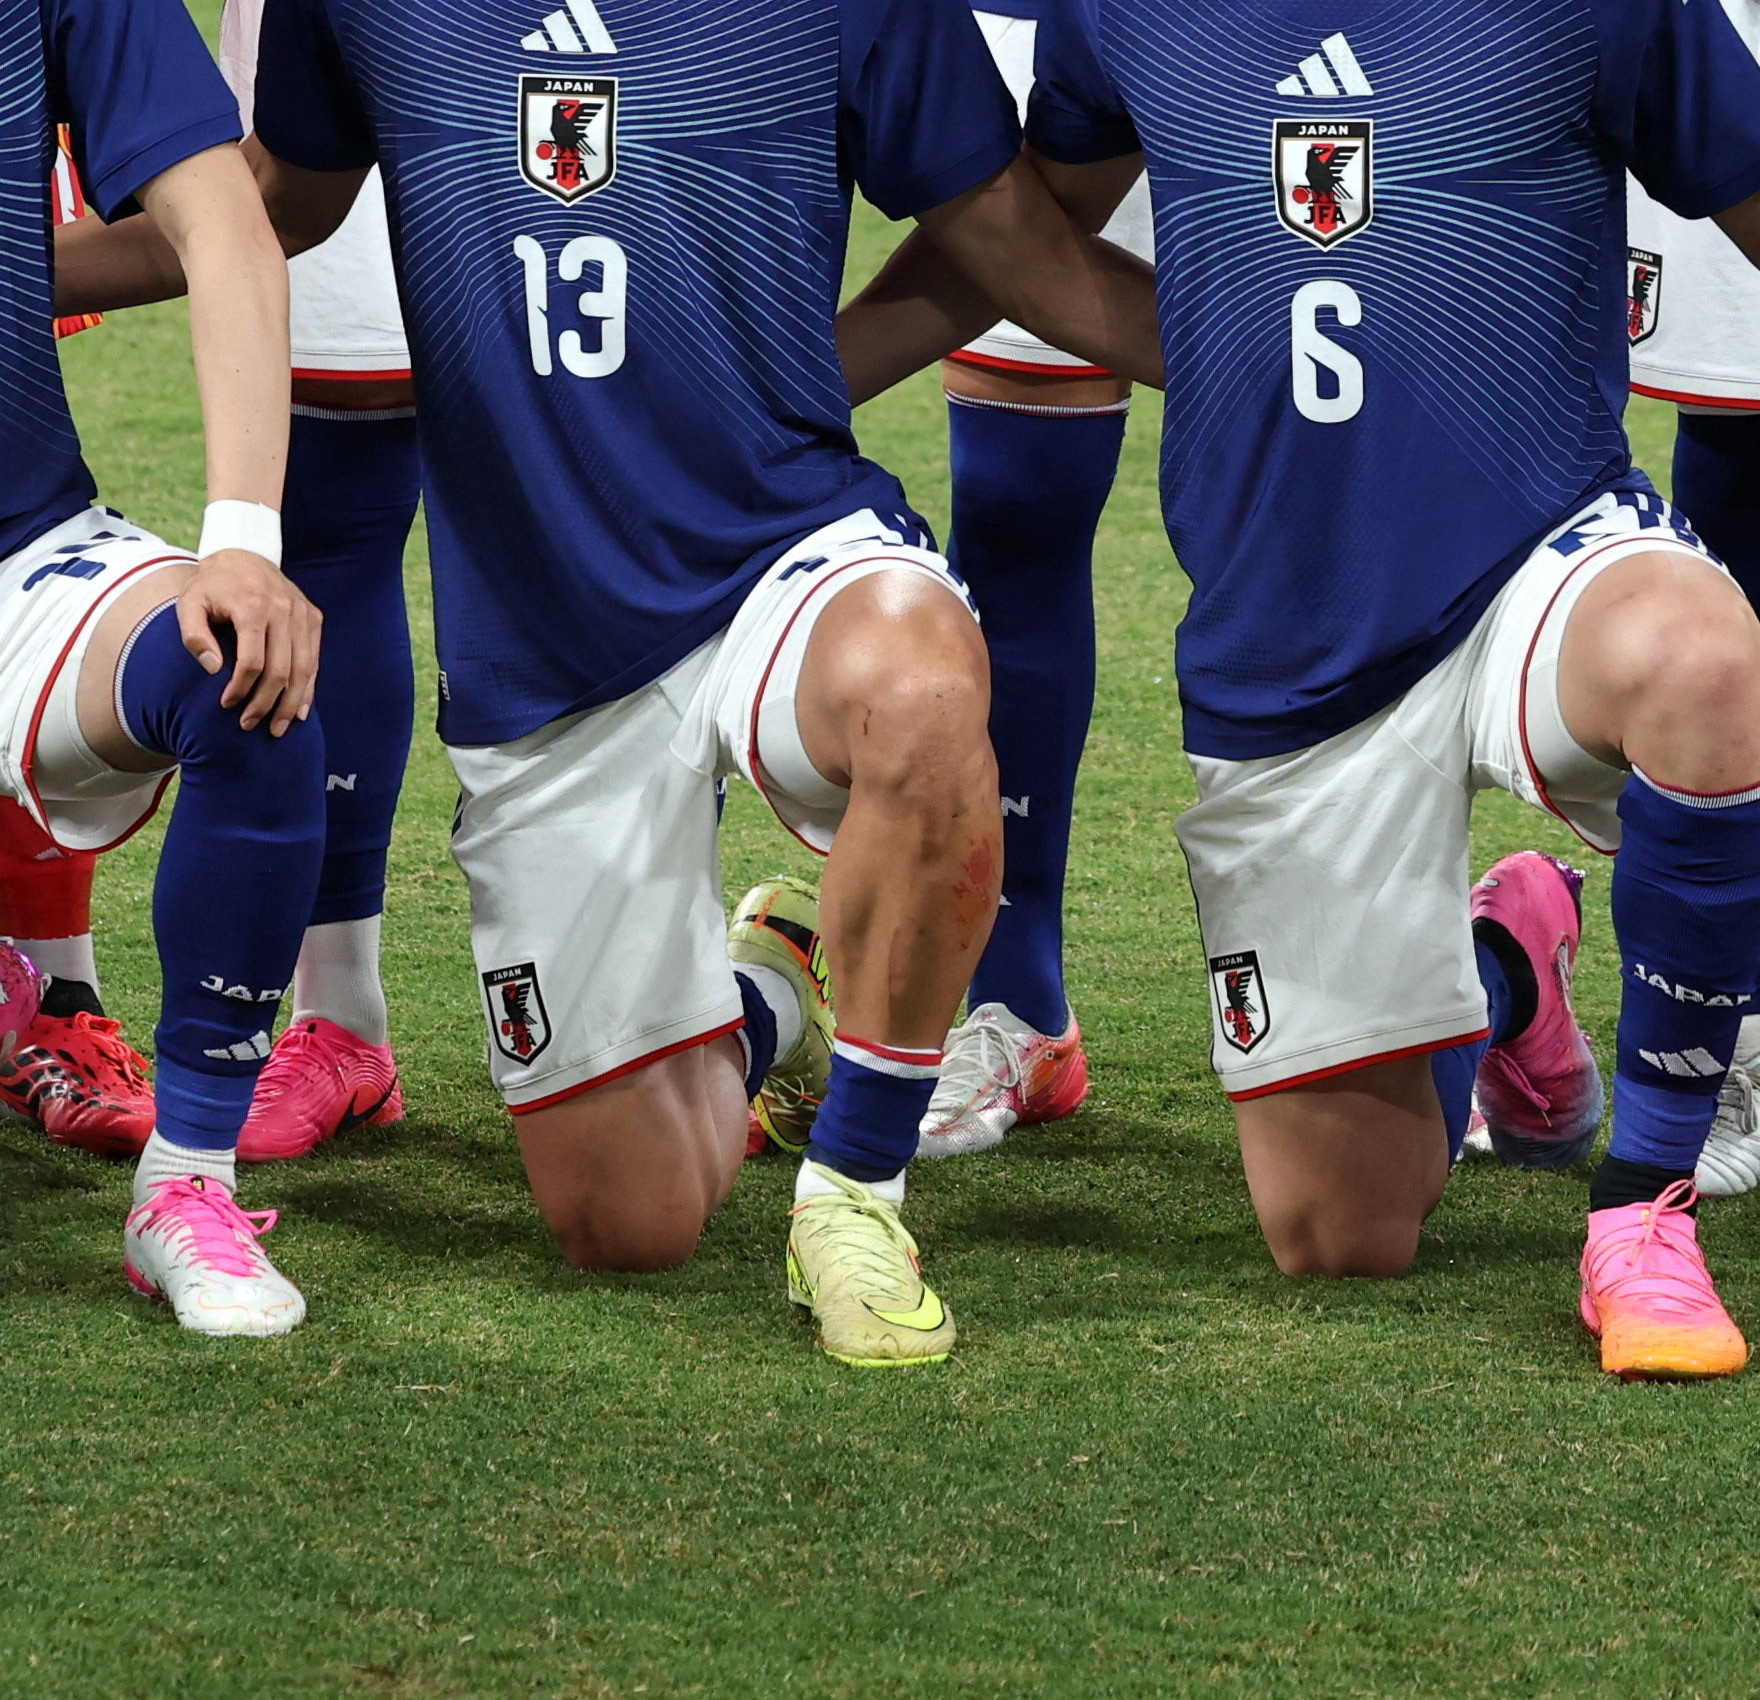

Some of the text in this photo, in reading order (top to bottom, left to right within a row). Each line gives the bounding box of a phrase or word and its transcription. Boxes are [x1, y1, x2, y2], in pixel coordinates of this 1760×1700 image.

[544, 81, 594, 93] JAPAN
[1297, 124, 1349, 136] JAPAN
[546, 161, 590, 181] JFA
[1304, 204, 1347, 225] JFA
[513, 234, 628, 378] 13
[1291, 280, 1364, 423] 6
[1217, 956, 1243, 967] JAPAN
[493, 967, 522, 981] JAPAN
